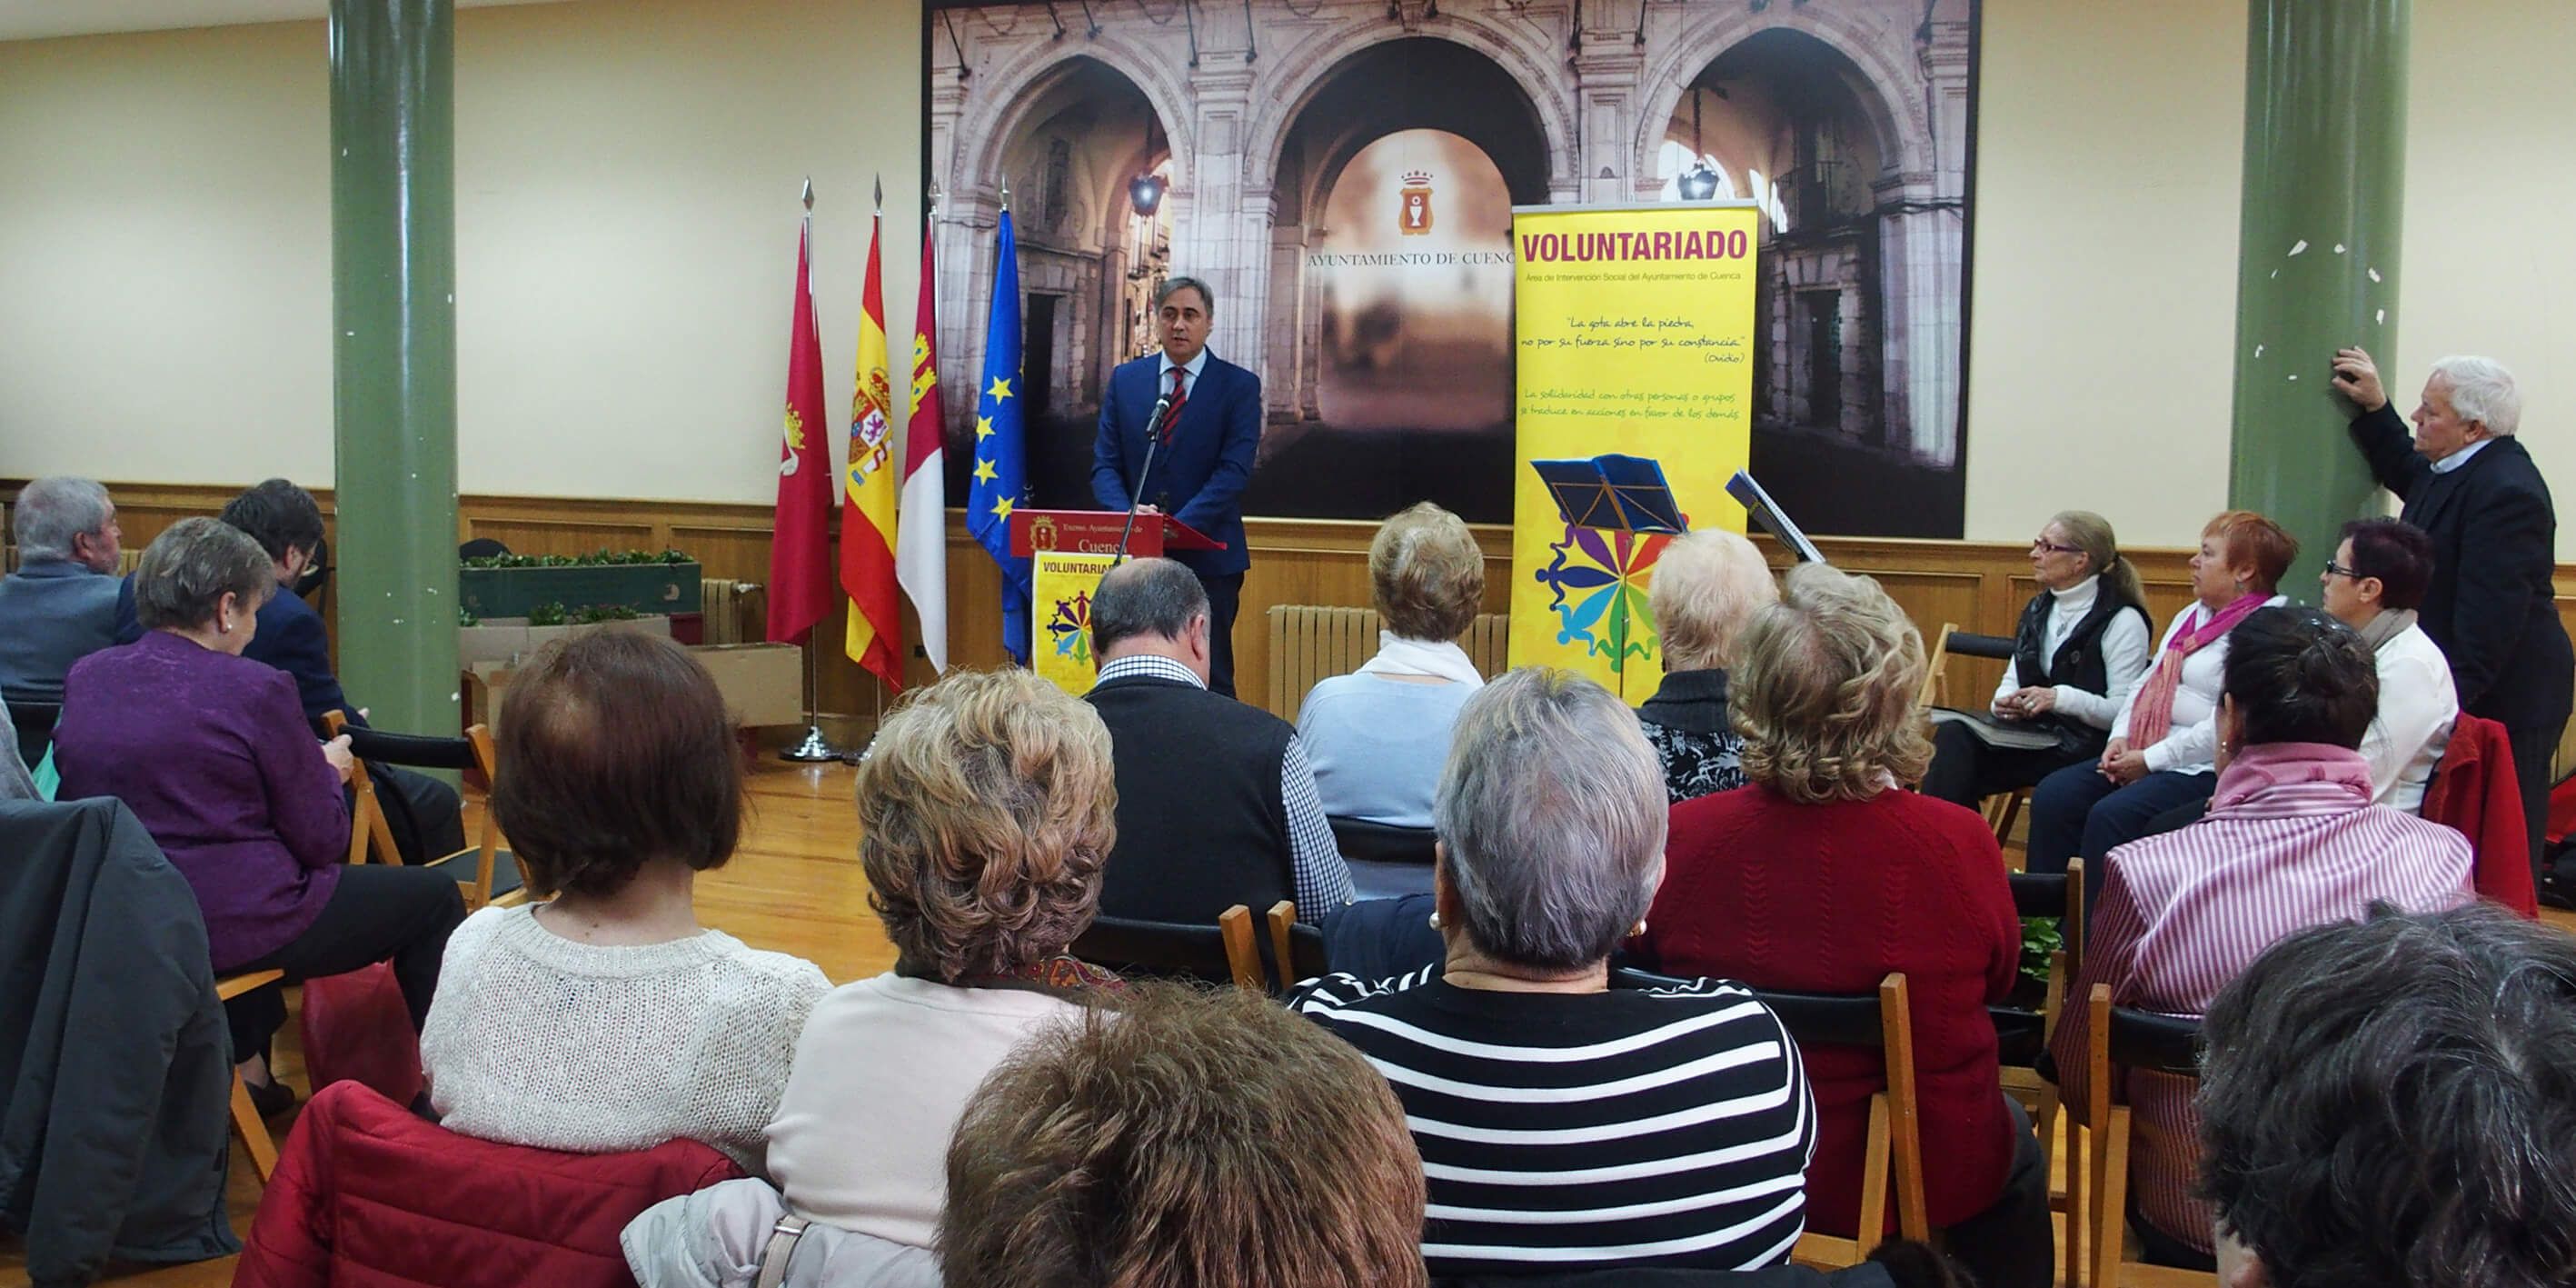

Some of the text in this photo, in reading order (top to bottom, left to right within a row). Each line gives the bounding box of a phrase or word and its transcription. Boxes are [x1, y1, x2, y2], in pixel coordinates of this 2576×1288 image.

[1521, 229, 1747, 262] VOLUNTARIADO
[1308, 251, 1516, 267] AYUNTAMIENTO DE CUENC
[1545, 274, 1555, 282] de
[1603, 273, 1626, 282] Social
[1628, 273, 1640, 281] del
[1642, 272, 1696, 283] Ayuntamiento
[1697, 273, 1708, 281] de
[1709, 271, 1741, 281] Cuenca
[1588, 315, 1611, 332] gota
[1614, 316, 1638, 328] abre
[1642, 316, 1656, 328] la
[1521, 338, 1534, 346] no
[1537, 339, 1556, 349] por
[1558, 337, 1573, 348] su
[1576, 334, 1611, 348] fuerza
[1613, 336, 1636, 348] sino
[1639, 338, 1658, 350] por
[1661, 338, 1676, 348] su
[1704, 352, 1746, 364] (Ovidio)
[1524, 387, 1537, 398] La
[1540, 388, 1596, 400] solidaridad
[1619, 389, 1645, 401] otras
[1647, 392, 1689, 404] personas
[1702, 393, 1736, 405] grupos
[1530, 404, 1566, 415] traduce
[1586, 408, 1626, 418] acciones
[1629, 409, 1644, 417] en
[1645, 405, 1669, 419] favor
[1673, 406, 1685, 418] de
[1687, 407, 1702, 421] los
[1134, 525, 1144, 534] de
